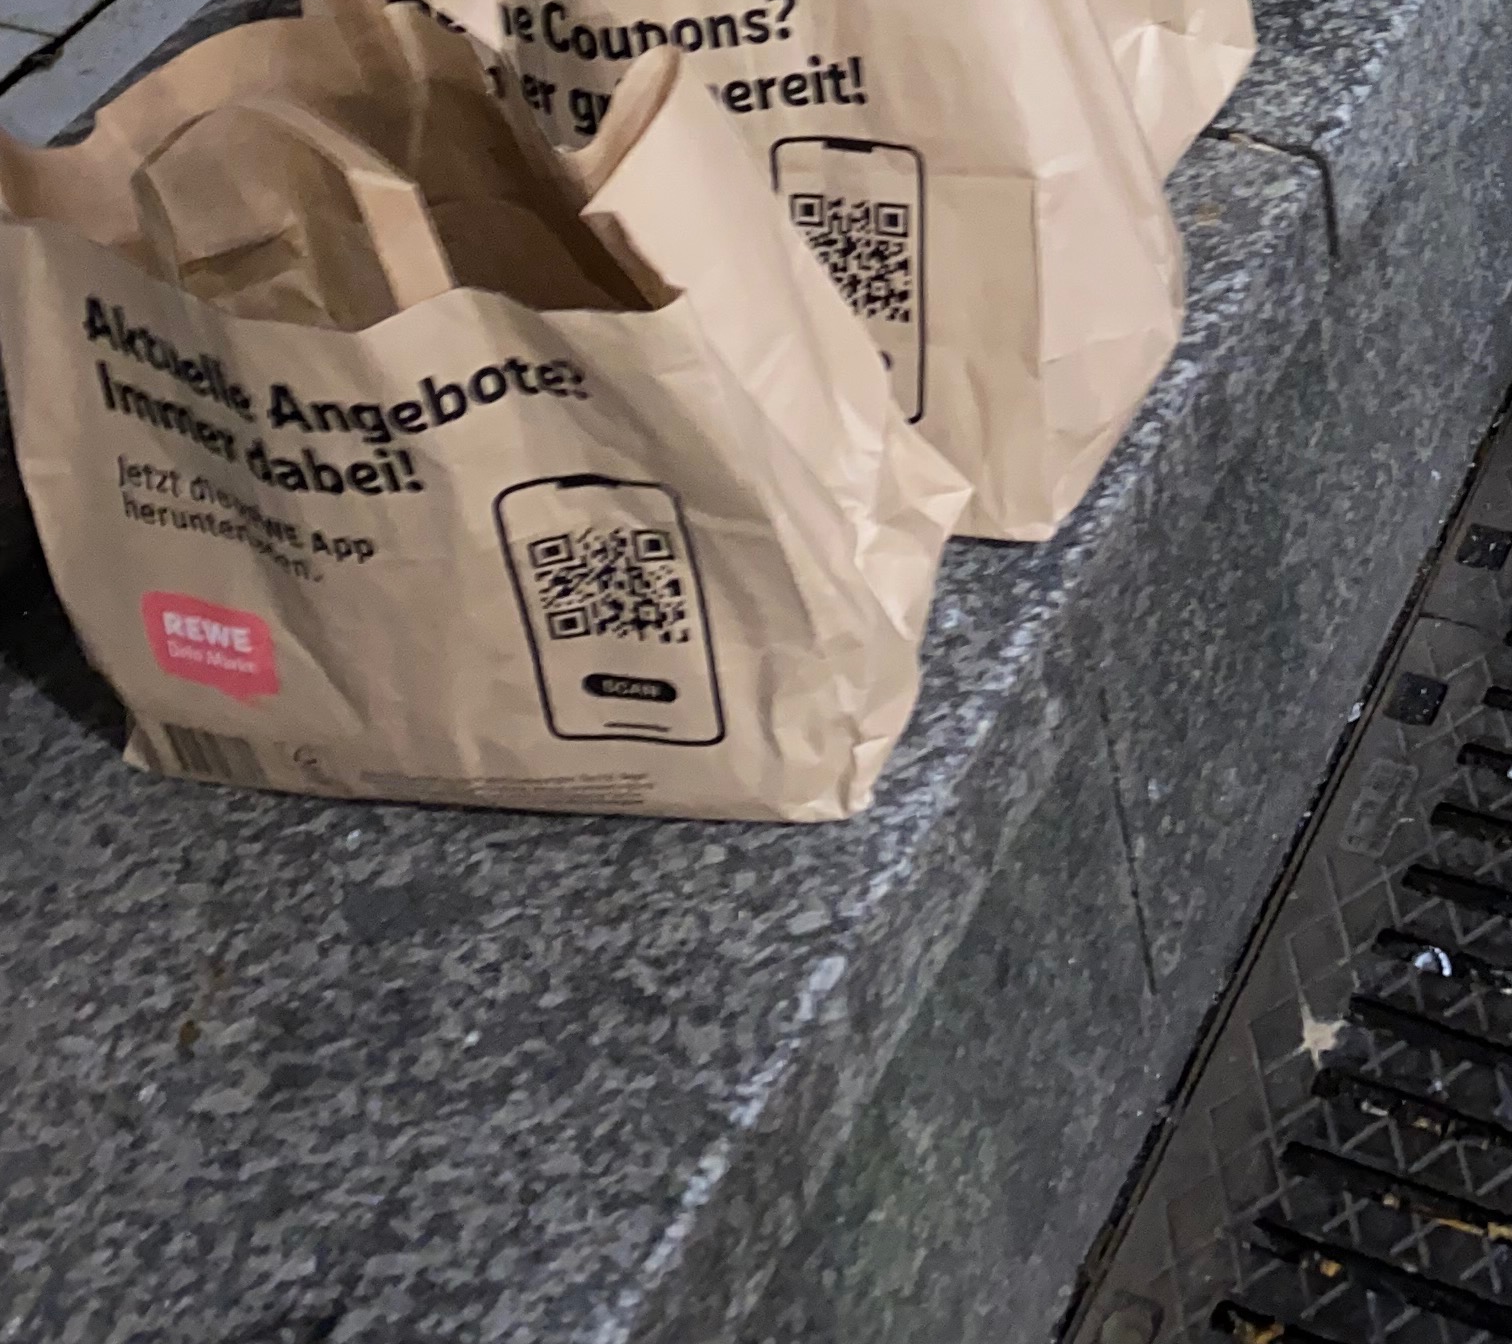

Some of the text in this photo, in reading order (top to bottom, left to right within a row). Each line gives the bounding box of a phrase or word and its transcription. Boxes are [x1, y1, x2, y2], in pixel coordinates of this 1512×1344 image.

[95, 359, 426, 497] Immer dabei!
[117, 454, 182, 499] Jetzt
[310, 529, 377, 565] App
[162, 610, 253, 654] REWE
